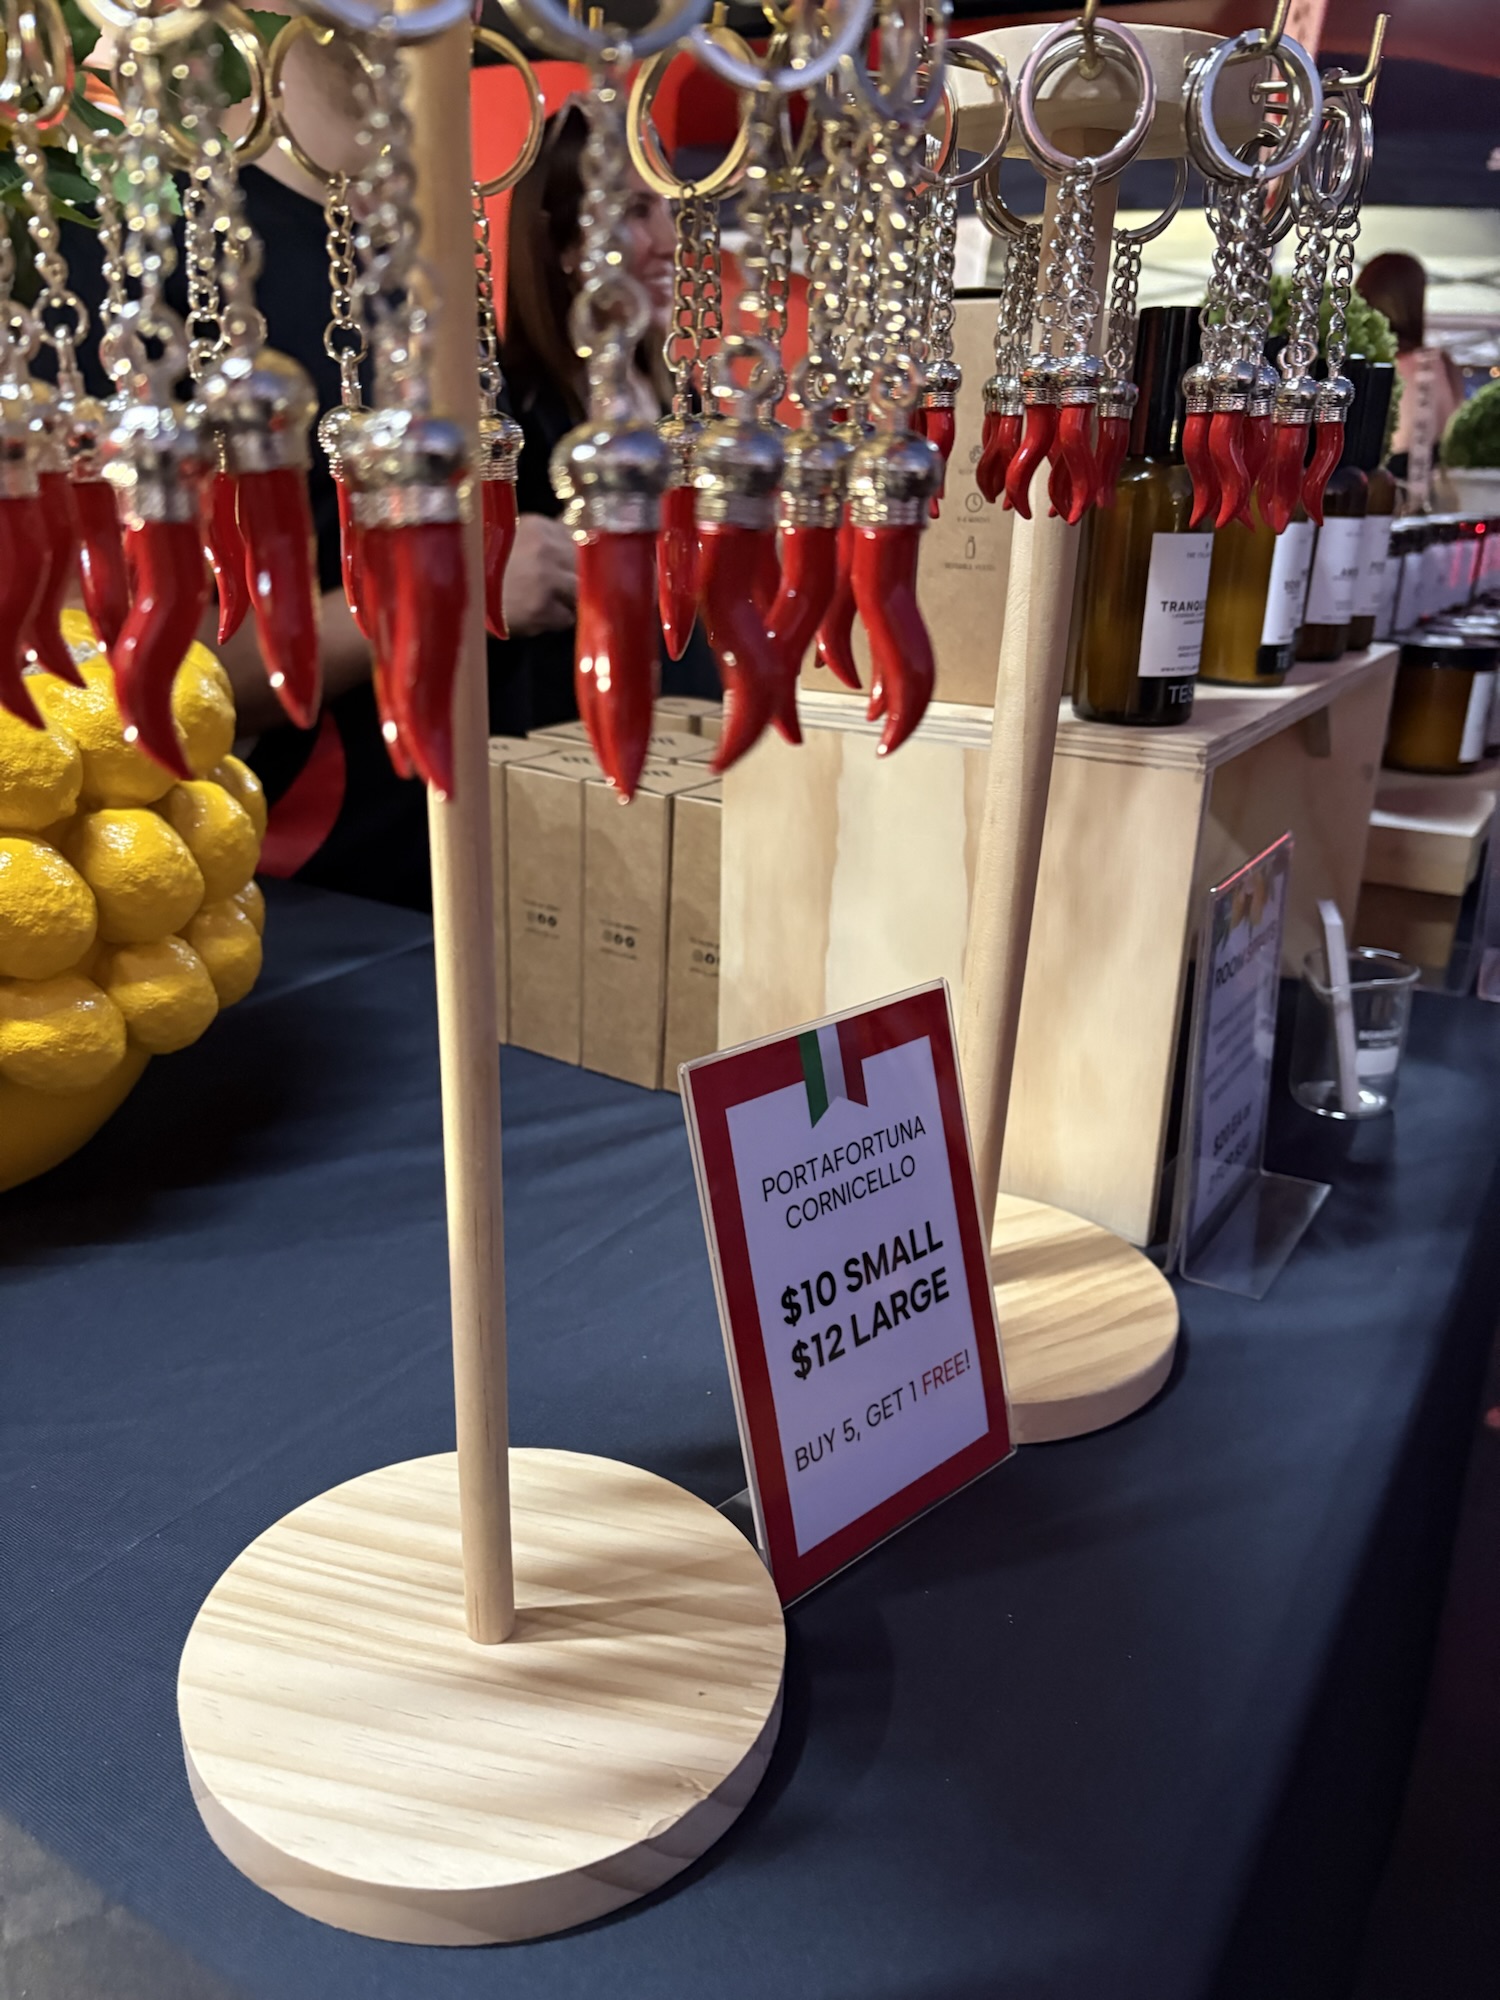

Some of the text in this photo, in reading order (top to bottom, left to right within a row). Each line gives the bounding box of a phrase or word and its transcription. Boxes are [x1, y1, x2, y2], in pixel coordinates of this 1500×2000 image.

[761, 1115, 926, 1202] PORTAFORTUNA
[786, 1155, 916, 1229] CORNICELLO
[780, 1221, 943, 1327] $10 SMALL
[791, 1267, 949, 1380] $12 LARGE
[795, 1349, 971, 1472] BUY 5, GET 1 FREE!
